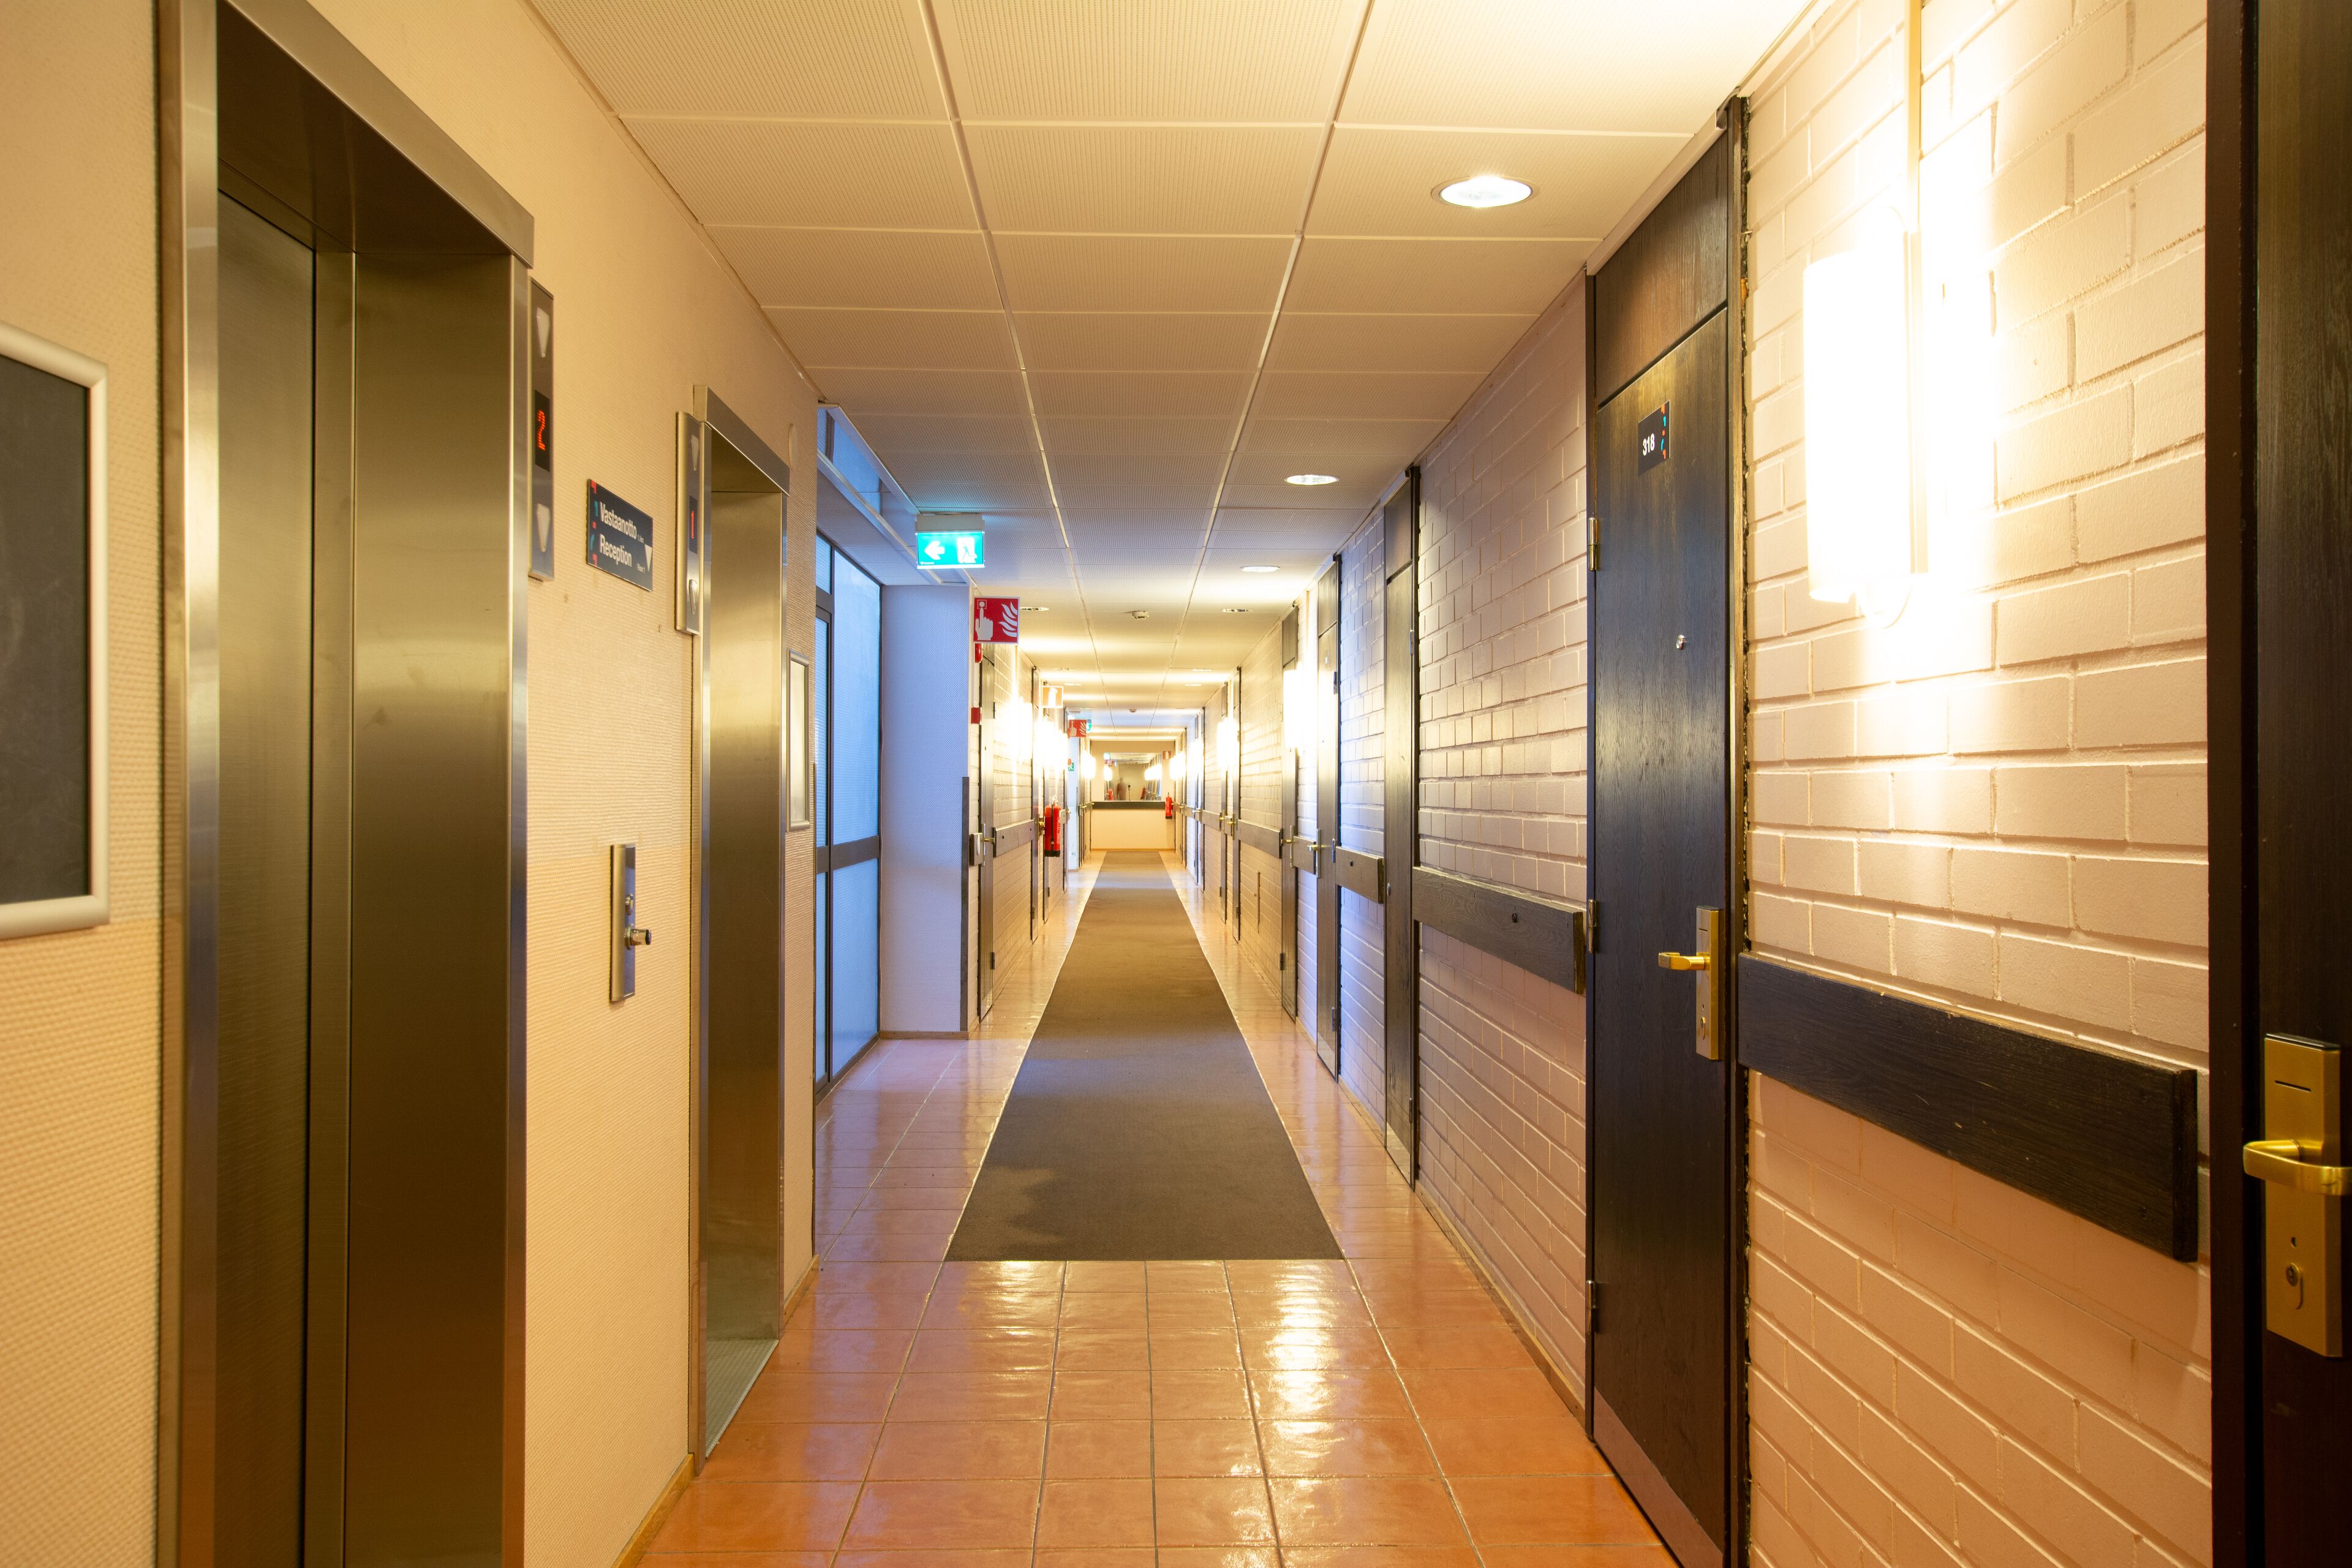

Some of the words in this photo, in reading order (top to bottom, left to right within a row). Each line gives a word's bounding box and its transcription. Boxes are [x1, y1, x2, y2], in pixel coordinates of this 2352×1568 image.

[538, 409, 546, 451] 2
[1642, 432, 1655, 456] 318
[600, 501, 637, 540] Vastaanotto
[600, 533, 632, 567] Reception
